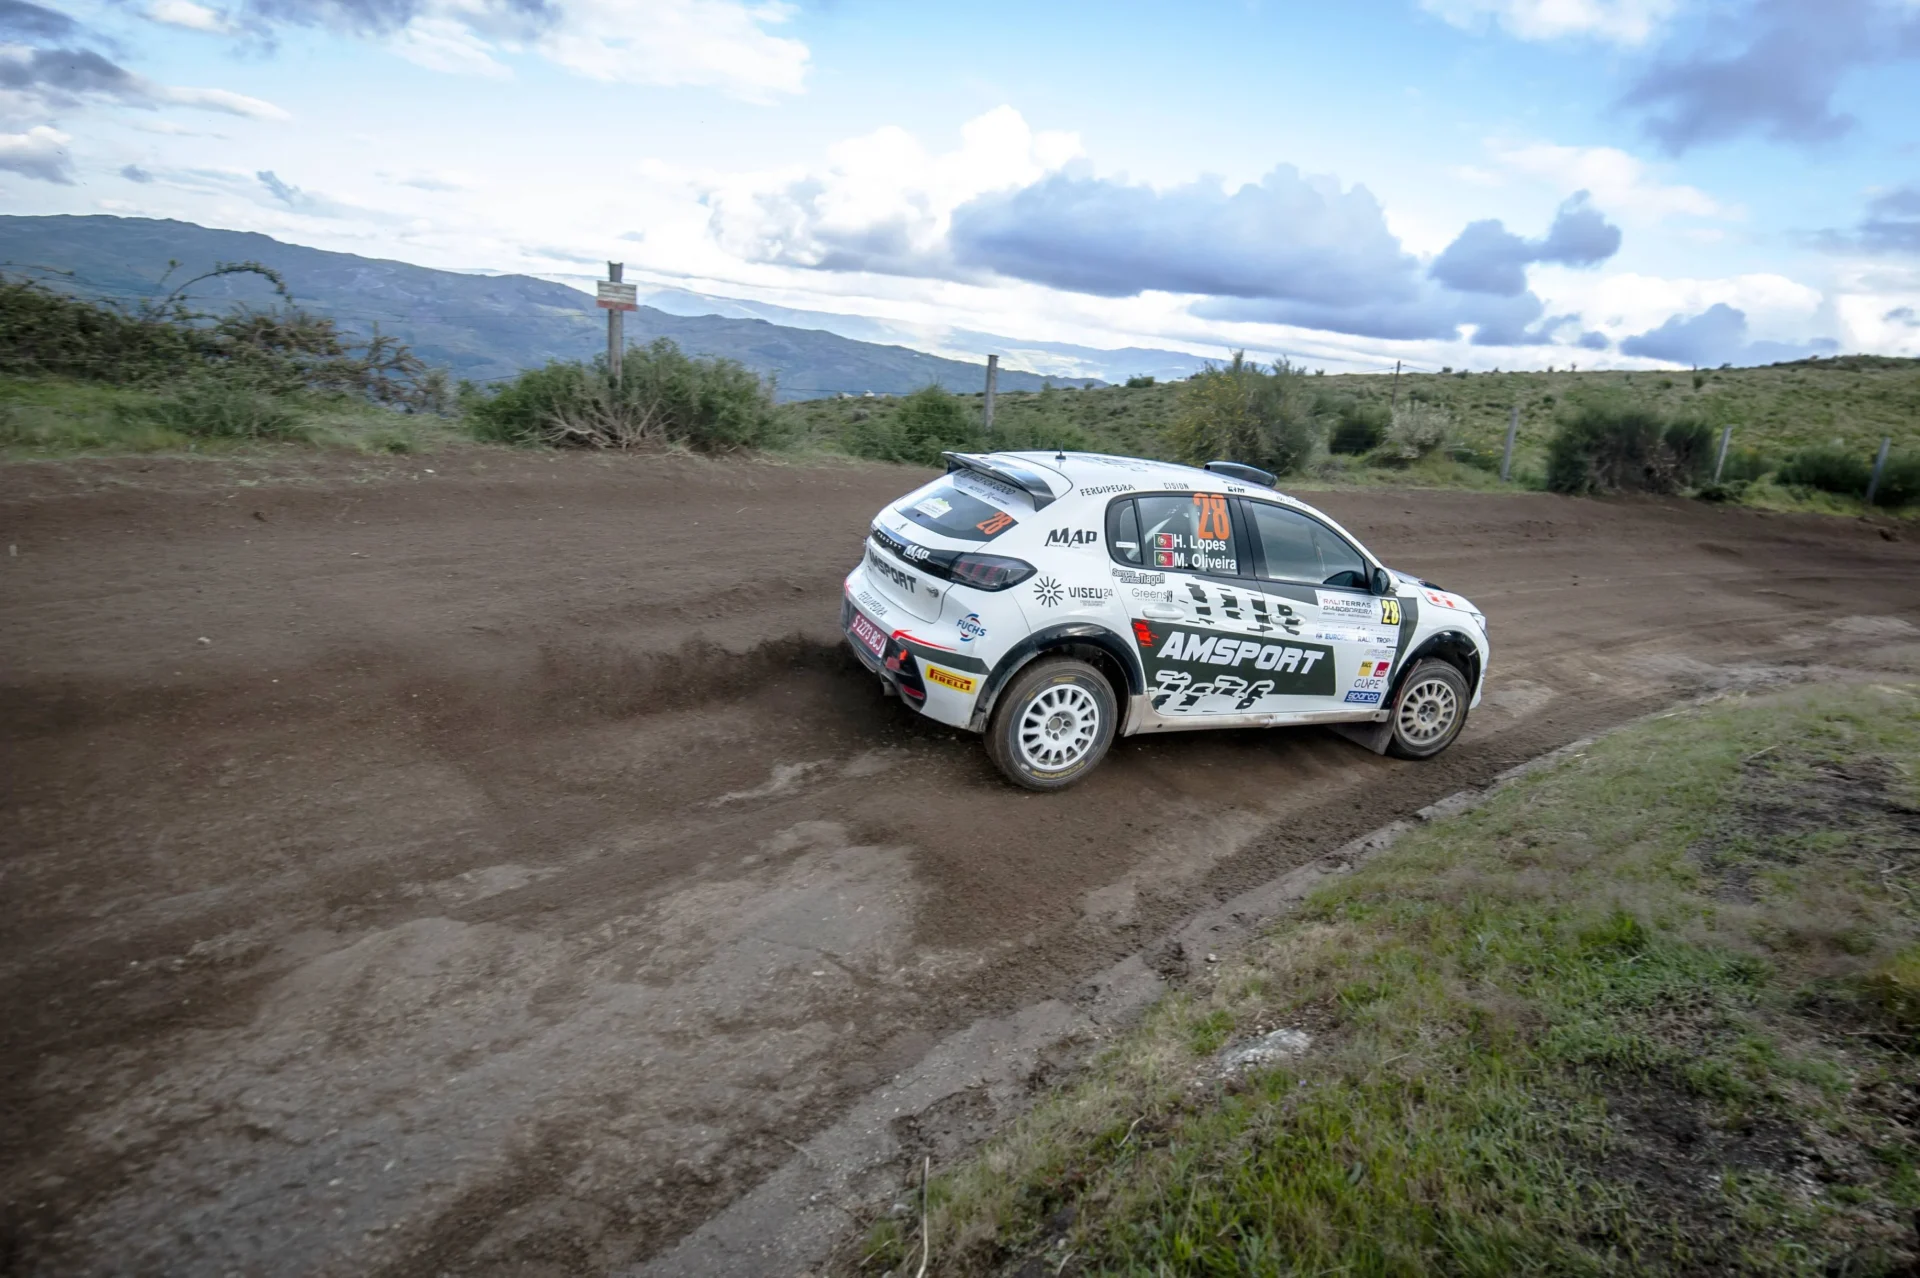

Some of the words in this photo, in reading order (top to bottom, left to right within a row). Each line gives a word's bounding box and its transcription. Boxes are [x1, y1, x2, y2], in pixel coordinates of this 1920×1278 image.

[1080, 484, 1135, 497] FERDIPEDRA
[976, 511, 1013, 535] 28
[1193, 493, 1230, 540] 28
[1044, 527, 1098, 548] MAP
[1173, 534, 1187, 549] H.
[1190, 534, 1226, 552] Lopes
[903, 544, 931, 562] MAP
[1174, 552, 1189, 567] M.
[1192, 554, 1237, 571] Oliveira
[1068, 587, 1102, 599] VISEU
[853, 615, 861, 628] S
[1381, 600, 1399, 625] 28
[956, 619, 987, 637] FUCHS
[1156, 631, 1326, 675] AMSPORT
[929, 668, 972, 691] PIRELLI
[1346, 692, 1379, 702] sparco
